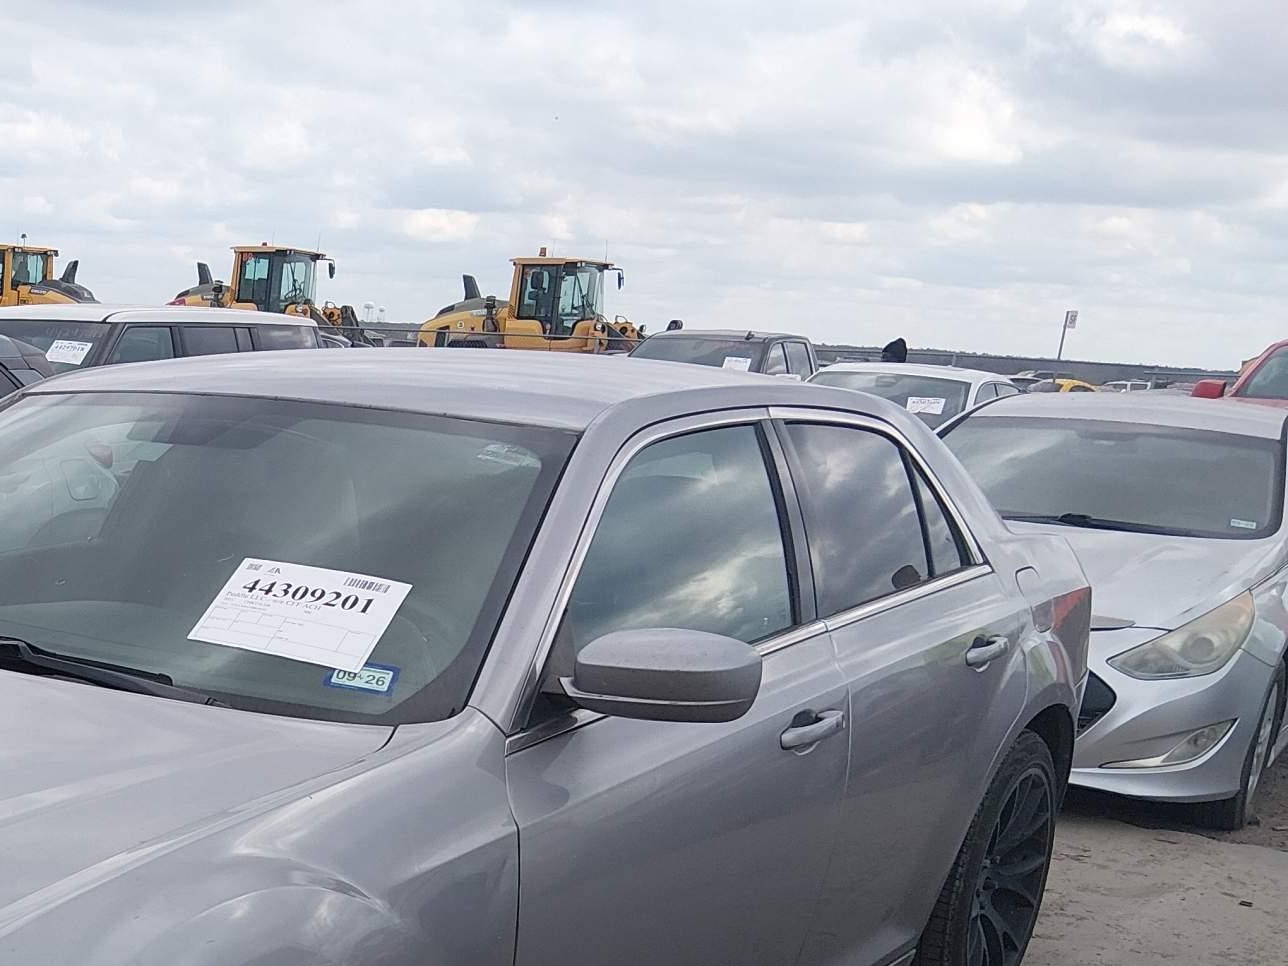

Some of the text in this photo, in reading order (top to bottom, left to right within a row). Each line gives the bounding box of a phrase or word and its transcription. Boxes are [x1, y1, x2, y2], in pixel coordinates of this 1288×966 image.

[241, 578, 376, 615] 44309201
[335, 669, 387, 687] 09 26
